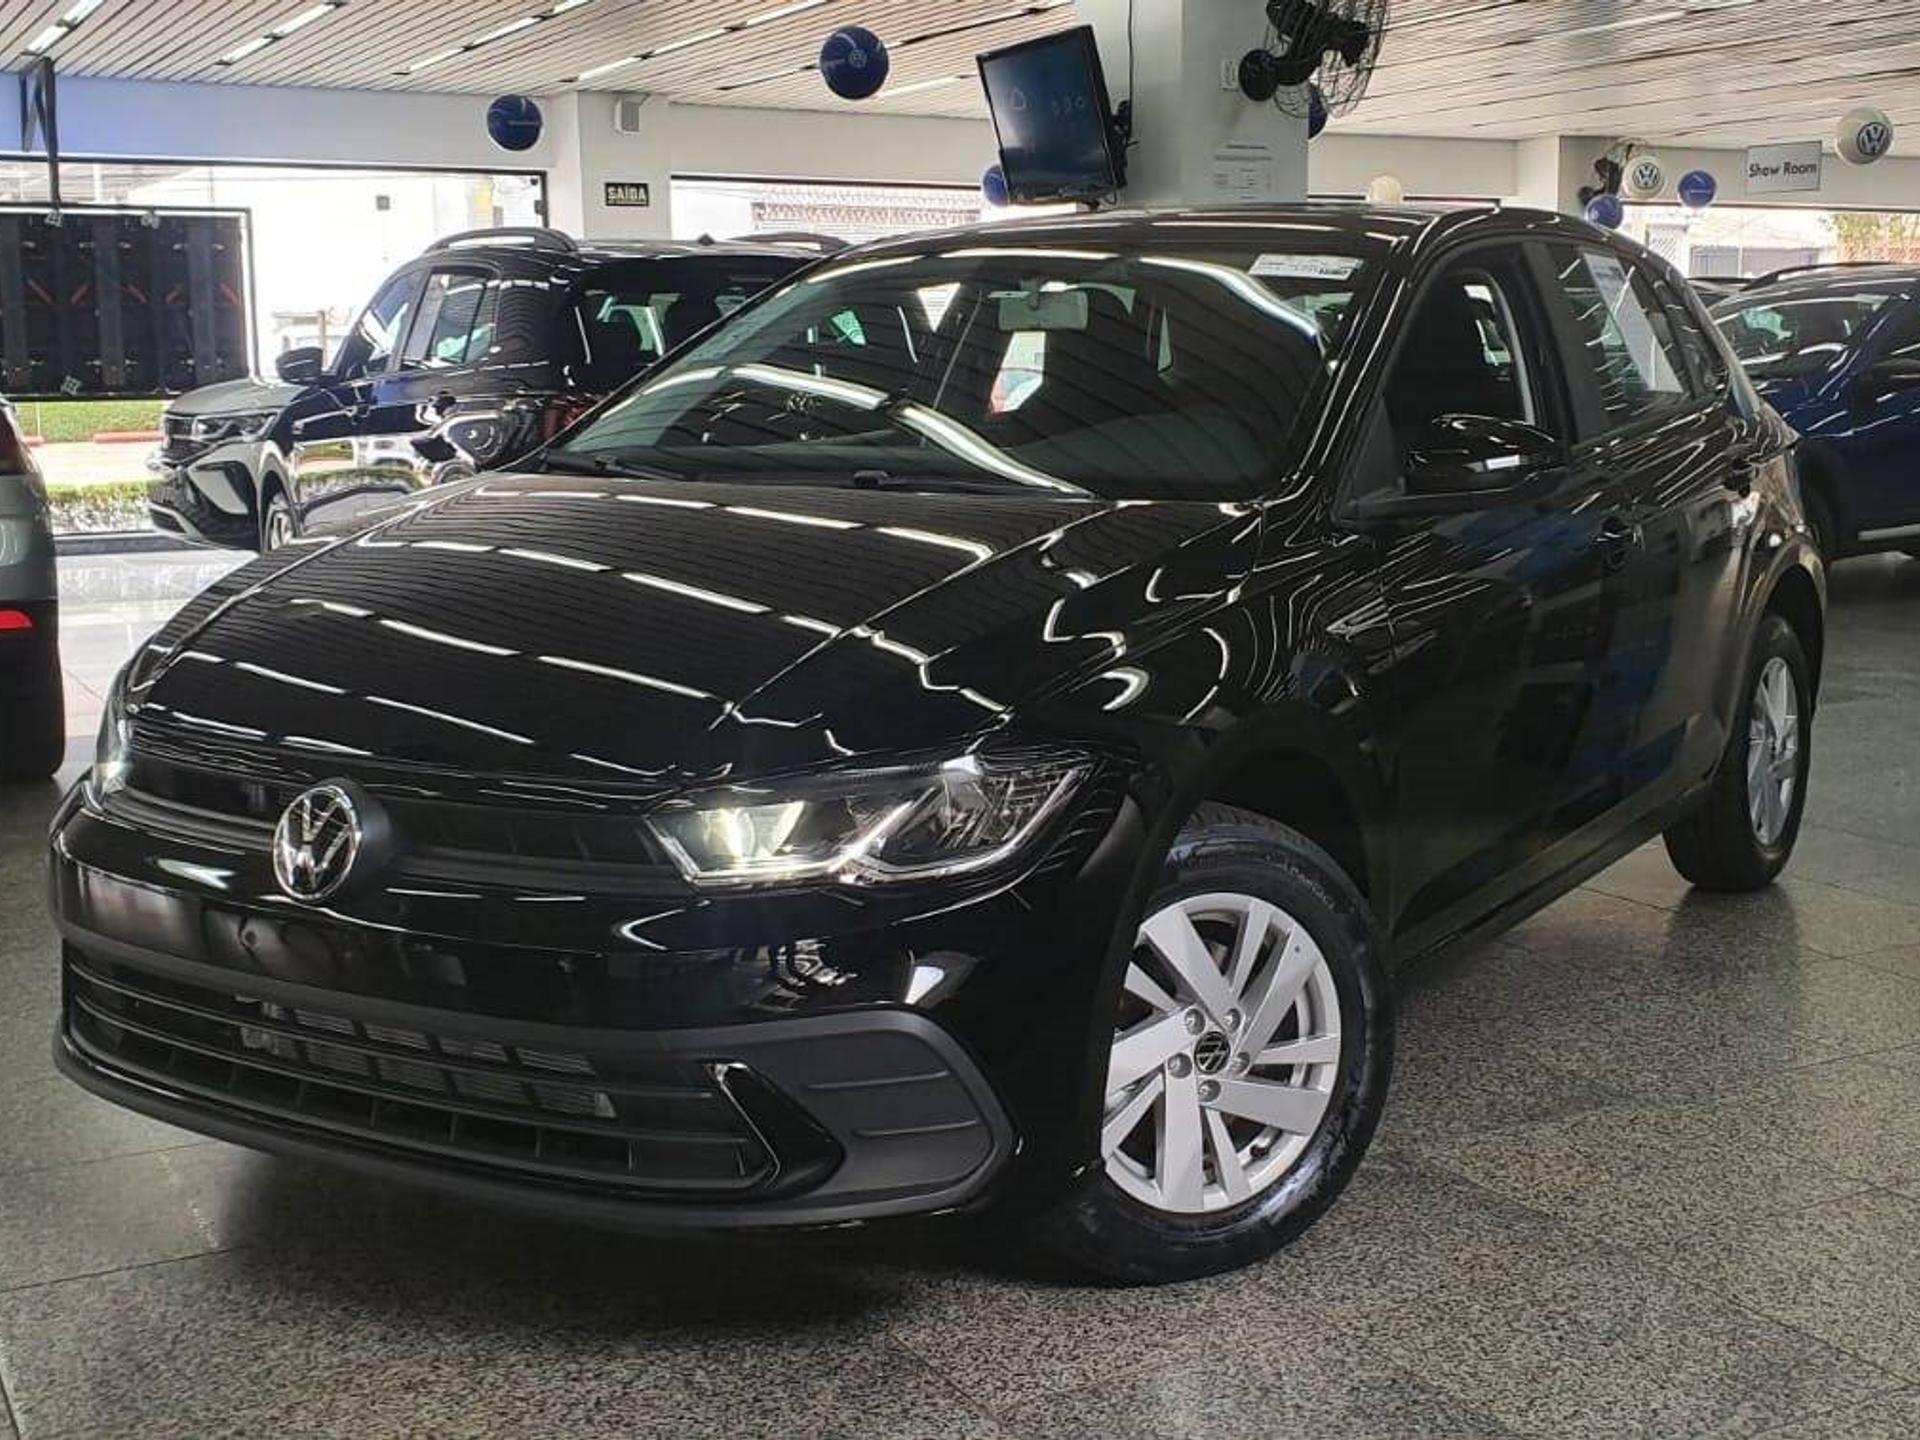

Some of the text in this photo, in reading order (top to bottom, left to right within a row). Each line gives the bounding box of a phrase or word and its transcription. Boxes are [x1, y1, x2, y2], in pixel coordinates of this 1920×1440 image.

[1748, 162, 1817, 178] Show Room
[273, 785, 361, 899] VW
